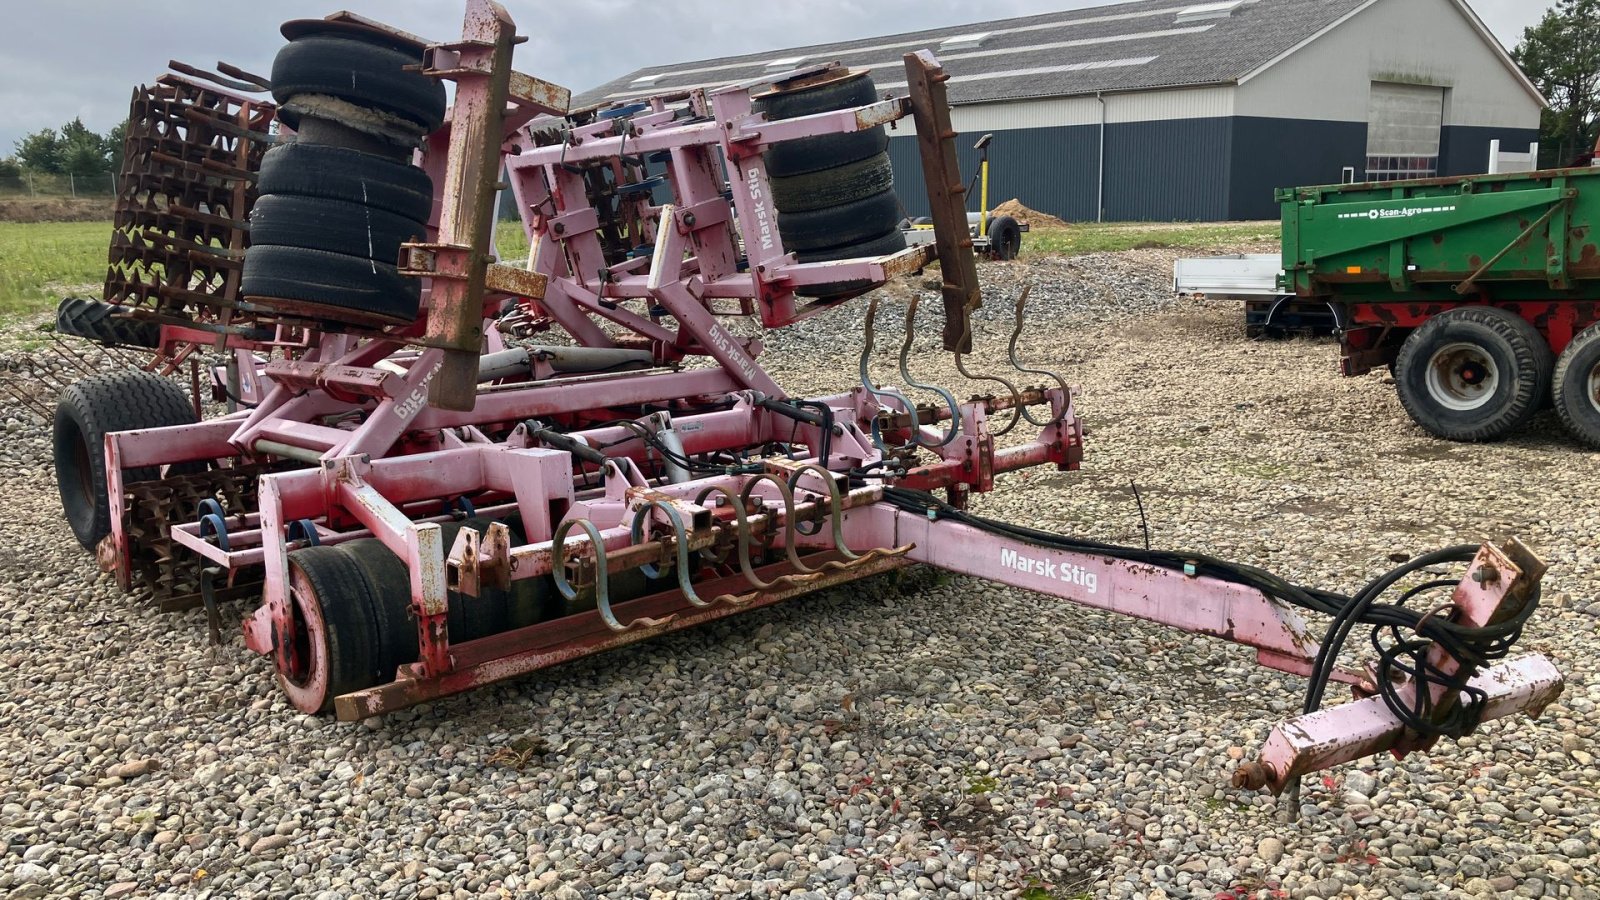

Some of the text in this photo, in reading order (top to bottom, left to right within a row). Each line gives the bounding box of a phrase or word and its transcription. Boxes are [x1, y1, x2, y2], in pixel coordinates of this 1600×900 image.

[747, 167, 774, 250] Marsk Stig
[1379, 206, 1422, 217] Scan-Agro
[708, 323, 757, 381] Marsk Stig
[393, 388, 425, 420] Stig
[1001, 548, 1097, 594] Marsk Stig
